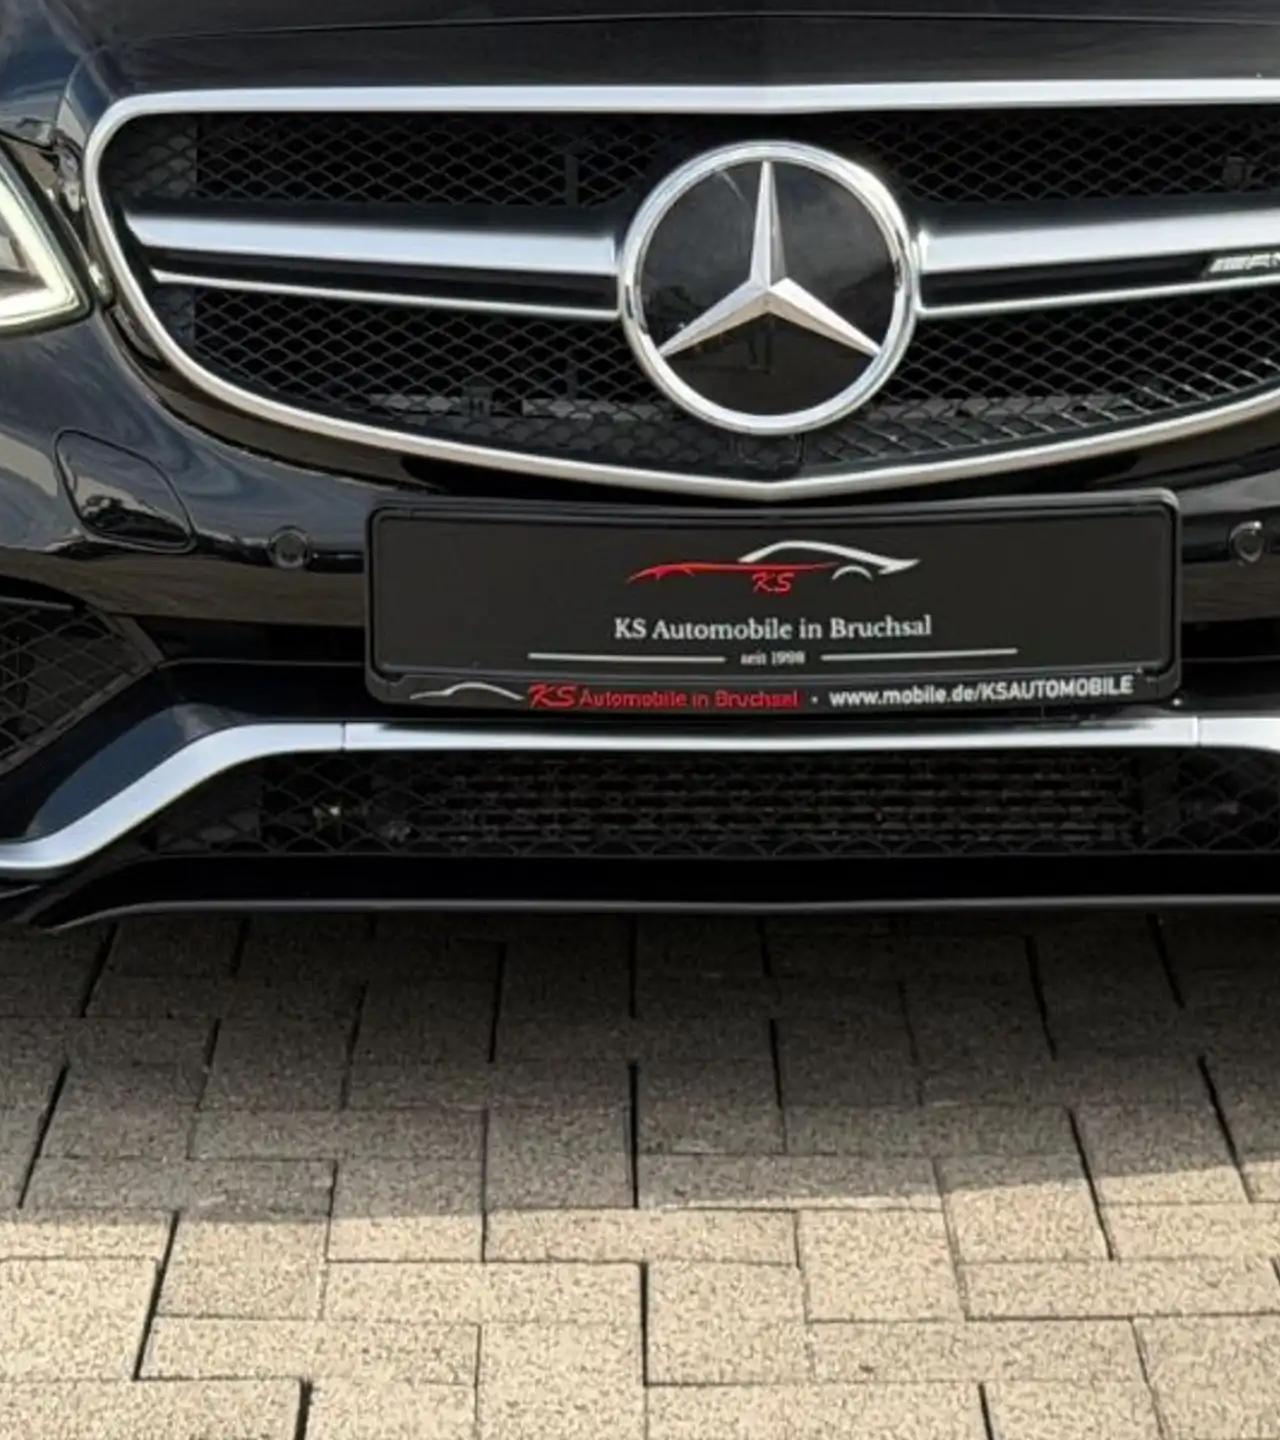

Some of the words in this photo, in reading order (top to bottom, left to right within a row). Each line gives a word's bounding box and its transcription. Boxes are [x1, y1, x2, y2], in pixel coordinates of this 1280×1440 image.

[751, 572, 795, 592] KS
[614, 617, 646, 640] KS
[652, 617, 792, 641] Automobile
[800, 617, 822, 639] in
[830, 615, 932, 639] Bruchsal
[528, 683, 577, 708] KS
[579, 689, 687, 708] Automobile
[692, 690, 709, 707] in
[715, 689, 798, 708] Bruchsal
[829, 674, 1135, 707] www.mobile.de/KSAUTOMOBILE
